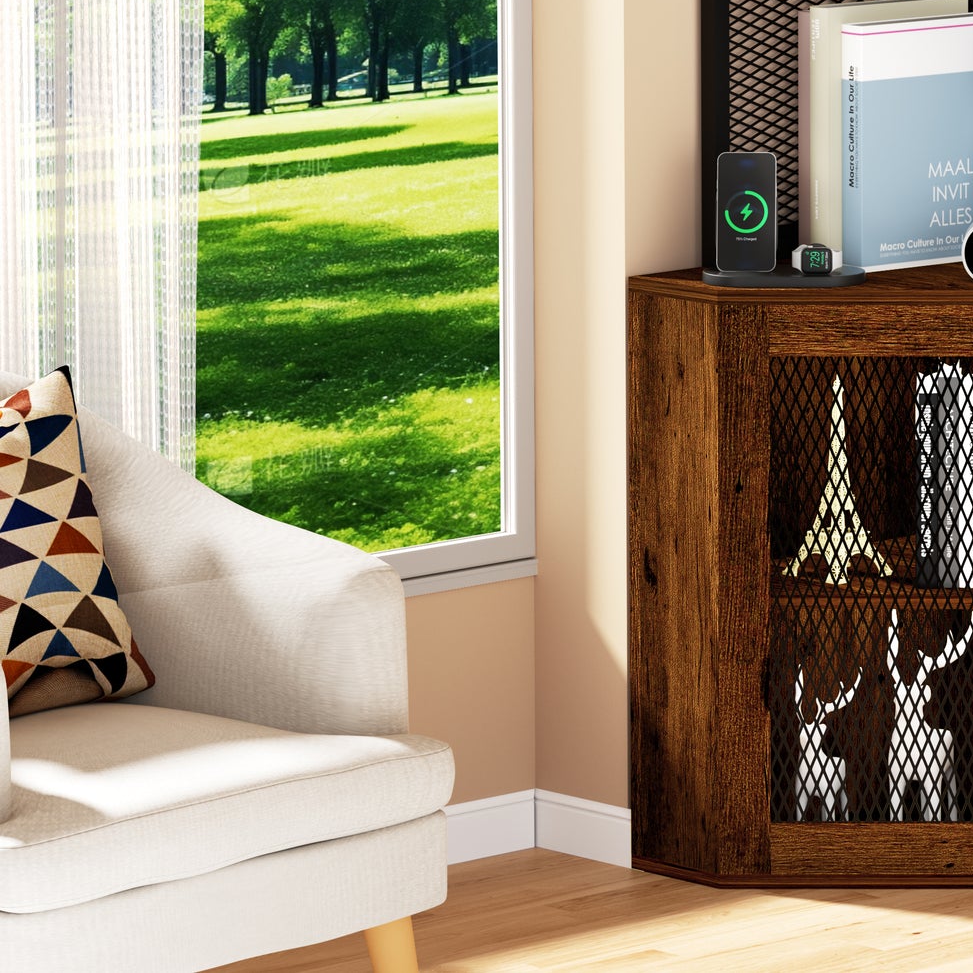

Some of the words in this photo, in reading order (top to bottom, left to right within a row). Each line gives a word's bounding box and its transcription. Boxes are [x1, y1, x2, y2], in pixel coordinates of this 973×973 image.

[848, 105, 855, 114] In
[928, 157, 973, 179] MAAL
[932, 182, 970, 202] INVIT
[929, 207, 972, 228] ALLES
[880, 242, 905, 252] Macro
[906, 237, 935, 249] Culture
[936, 236, 944, 245] In
[945, 235, 959, 244] Our
[810, 251, 820, 268] 7:29
